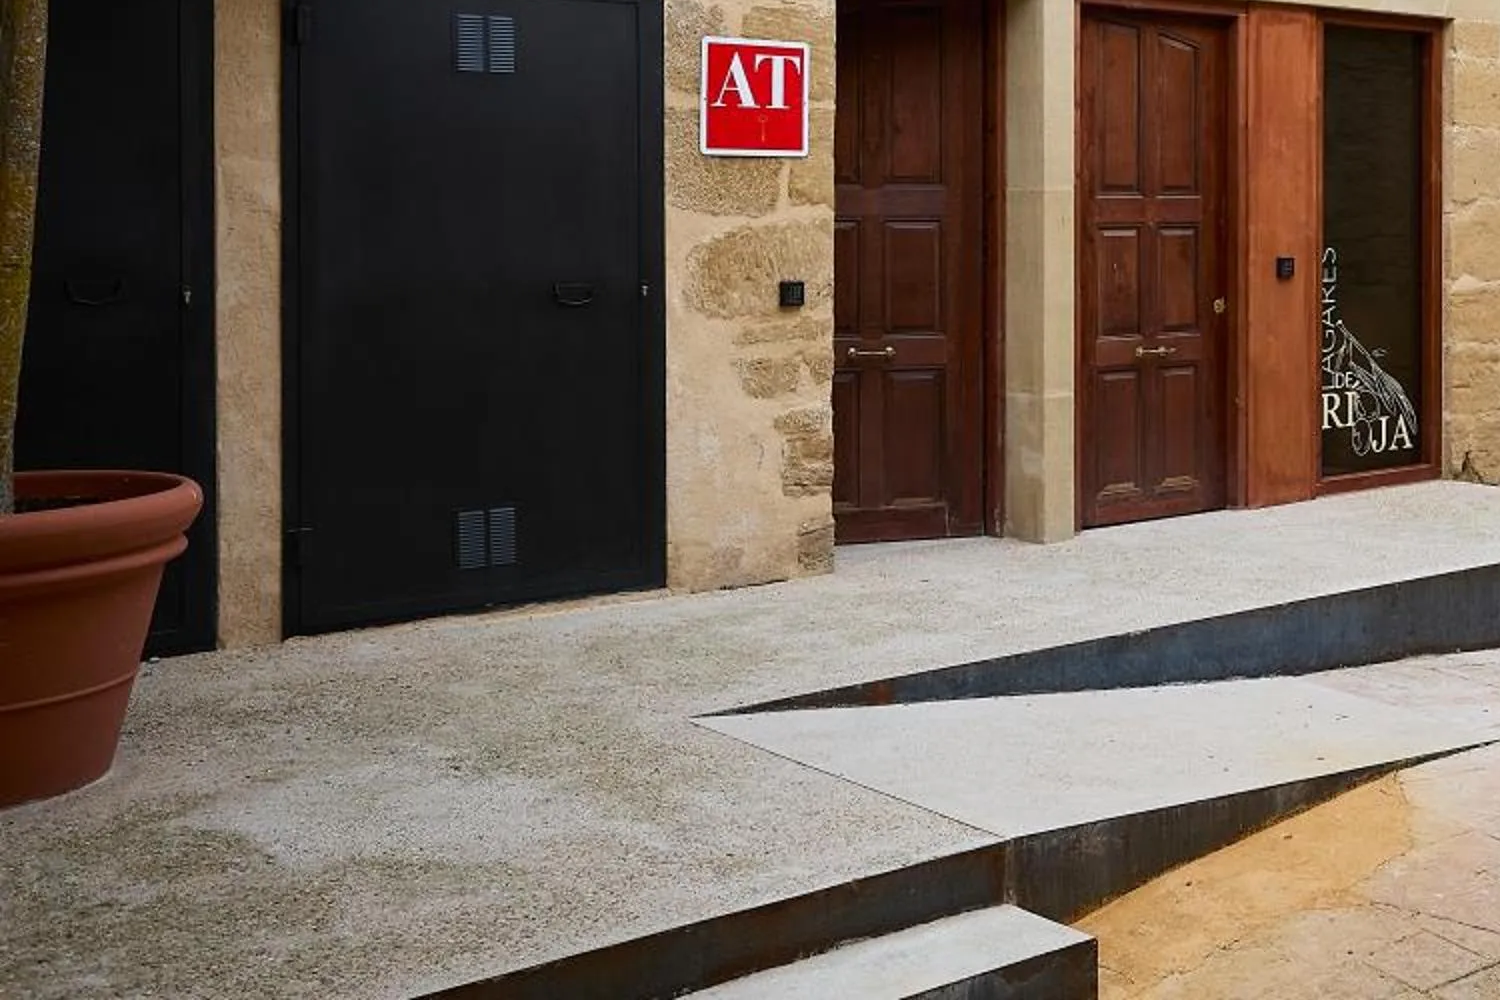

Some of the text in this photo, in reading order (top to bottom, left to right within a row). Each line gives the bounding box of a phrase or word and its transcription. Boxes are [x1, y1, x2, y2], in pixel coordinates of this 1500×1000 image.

[710, 51, 801, 109] AT
[1321, 247, 1337, 390] LAGARES
[1335, 371, 1355, 389] DE
